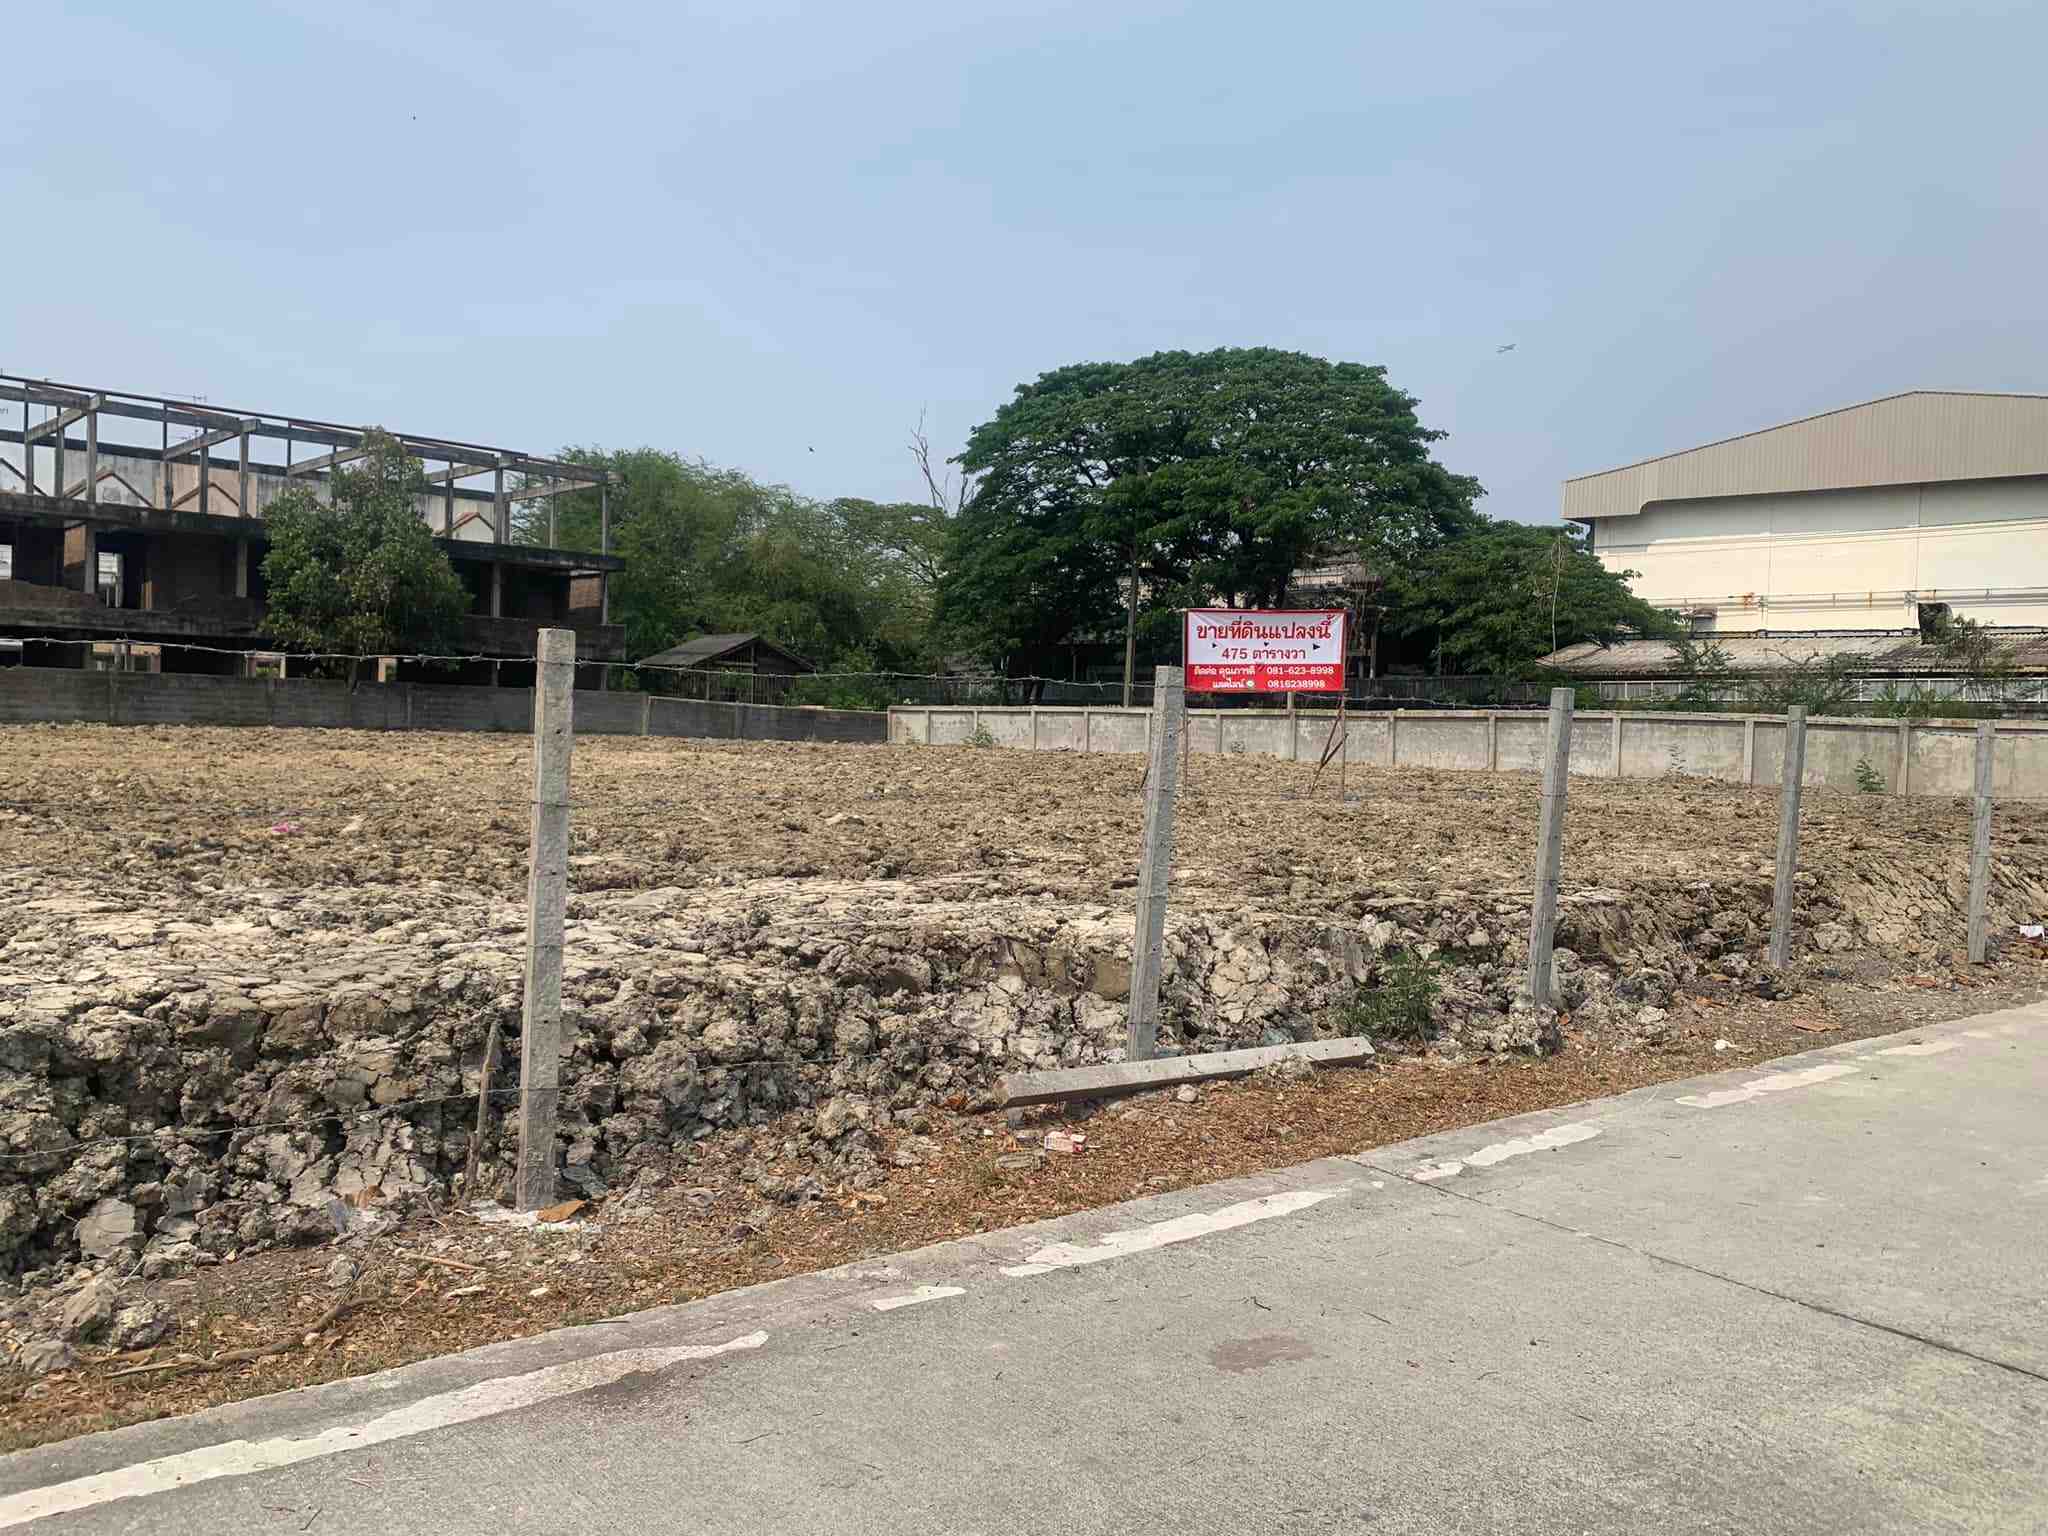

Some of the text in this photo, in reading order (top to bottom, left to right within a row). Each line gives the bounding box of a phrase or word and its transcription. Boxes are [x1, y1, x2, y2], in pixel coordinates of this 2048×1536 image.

[1197, 614, 1331, 639] ขายที่ดินแปลงนี้
[1222, 648, 1306, 659] 475 ตารางวา
[1266, 666, 1334, 675] 081-623-8998
[1267, 679, 1326, 688] 0816238998
